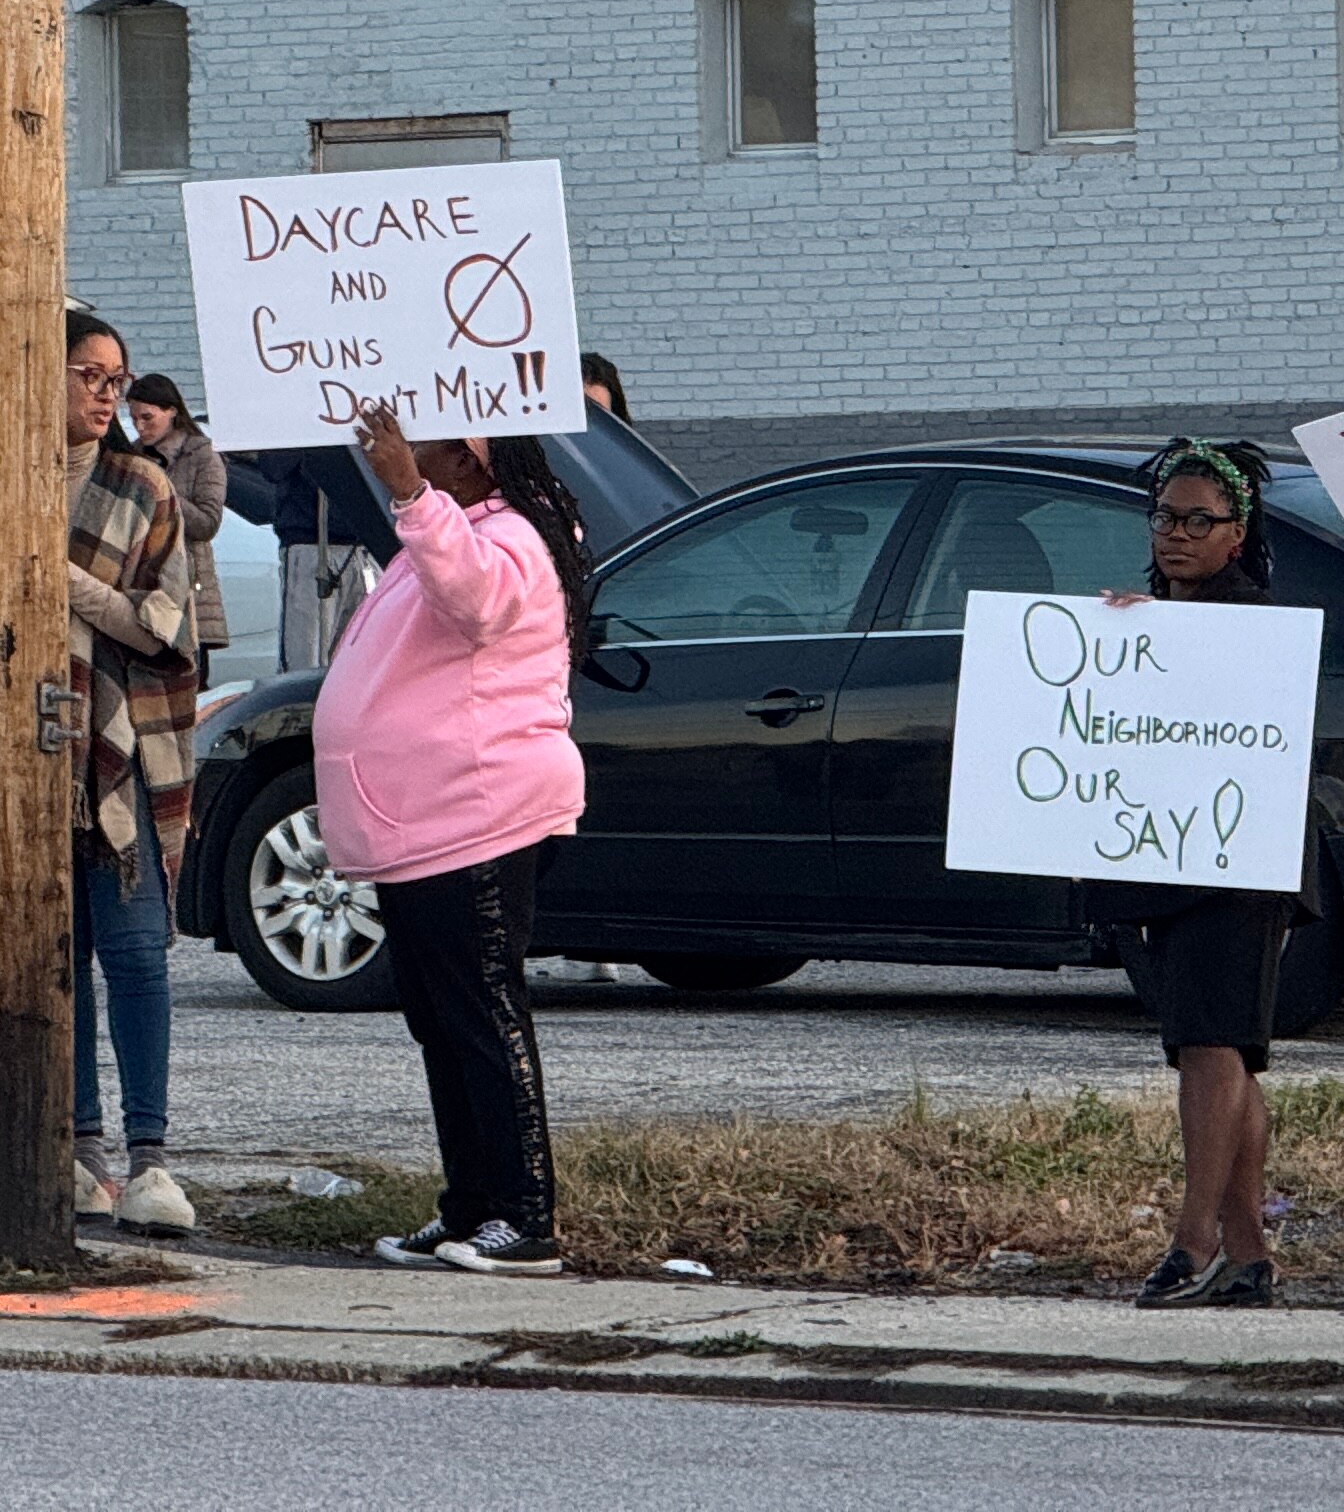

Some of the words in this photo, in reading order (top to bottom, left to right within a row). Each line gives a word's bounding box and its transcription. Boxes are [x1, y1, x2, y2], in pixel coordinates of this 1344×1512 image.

[239, 194, 479, 262] DAYCARE
[331, 271, 387, 305] AND
[252, 306, 383, 375] GUNS
[1023, 601, 1169, 687] OUR
[1016, 747, 1146, 809] OUR
